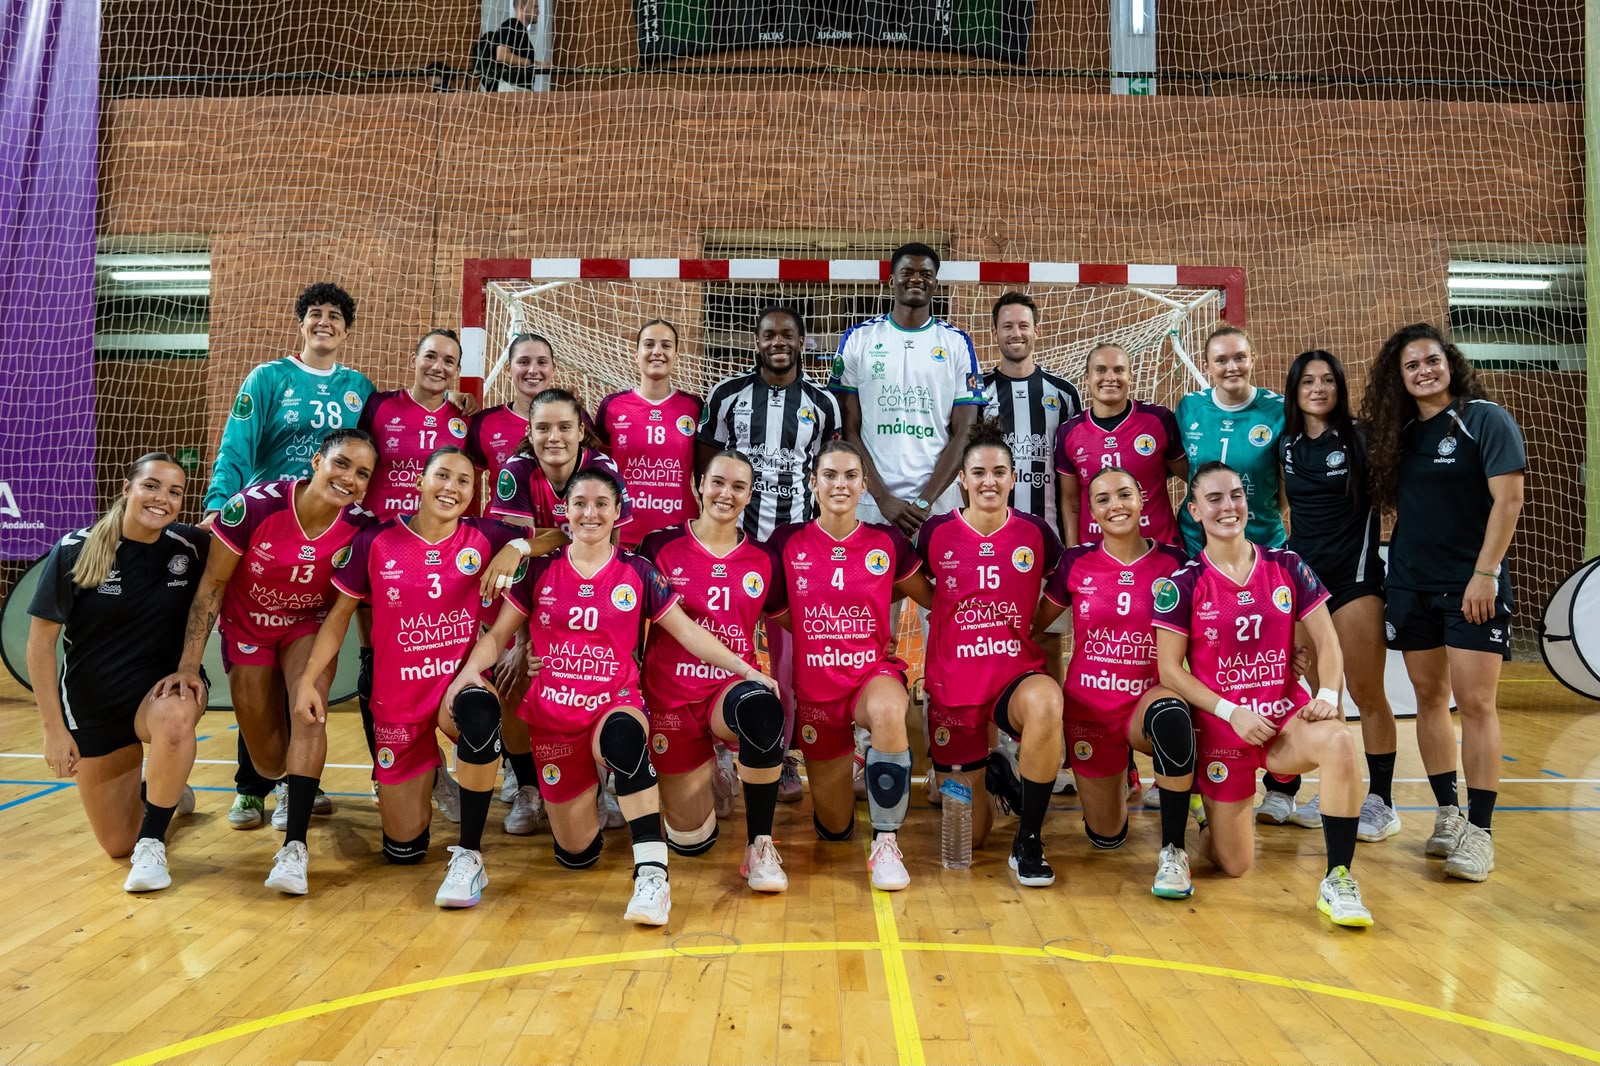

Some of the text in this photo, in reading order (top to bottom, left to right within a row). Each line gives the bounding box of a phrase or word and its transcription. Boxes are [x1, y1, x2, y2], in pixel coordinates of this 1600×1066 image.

[643, 4, 657, 16] 13
[645, 31, 659, 43] 15
[758, 31, 784, 41] FALTAS
[816, 31, 853, 40] JUGADOR
[882, 32, 908, 41] FALTAS
[881, 382, 931, 398] MÁLAGA
[877, 395, 935, 411] COMPITE
[309, 400, 343, 429] 38
[292, 433, 322, 445] MÁL
[418, 429, 438, 449] 17
[645, 425, 666, 445] 18
[1013, 444, 1052, 457] MPITE
[1220, 437, 1229, 464] 1
[392, 457, 424, 470] MÁL
[627, 454, 681, 469] MÁLAGA
[1101, 452, 1122, 469] 81
[623, 468, 684, 482] COMPITE
[1014, 469, 1051, 488] laga
[385, 493, 422, 510] mál
[2, 520, 45, 529] Andalucía
[289, 564, 315, 584] 13
[831, 567, 845, 591] 4
[976, 565, 1001, 590] 15
[252, 582, 323, 603] MÁLAGA
[427, 573, 442, 599] 3
[707, 586, 731, 611] 21
[957, 597, 1018, 614] MÁLAGA
[1116, 591, 1131, 616] 9
[400, 608, 471, 630] MÁLAGA
[568, 606, 599, 632] 20
[804, 603, 871, 619] MÁLAGA
[803, 618, 877, 633] COMPITE
[966, 622, 996, 630] PROVINCIA
[1235, 614, 1263, 642] 27
[715, 636, 750, 652] PITE
[1087, 626, 1154, 645] MÁLAGA
[412, 642, 444, 652] PROVINCIA
[549, 640, 615, 660] MÁLAGA
[1084, 640, 1158, 659] COMPITE
[541, 655, 620, 676] COMPITE
[1093, 656, 1123, 665] PROVINCIA
[1218, 648, 1287, 670] MÁLAGA
[400, 657, 462, 681] mála
[551, 671, 583, 681] PROVINCIA
[1216, 662, 1287, 685] COMPIT
[1230, 682, 1261, 691] PROVINCIA
[652, 720, 683, 728] OMPITE
